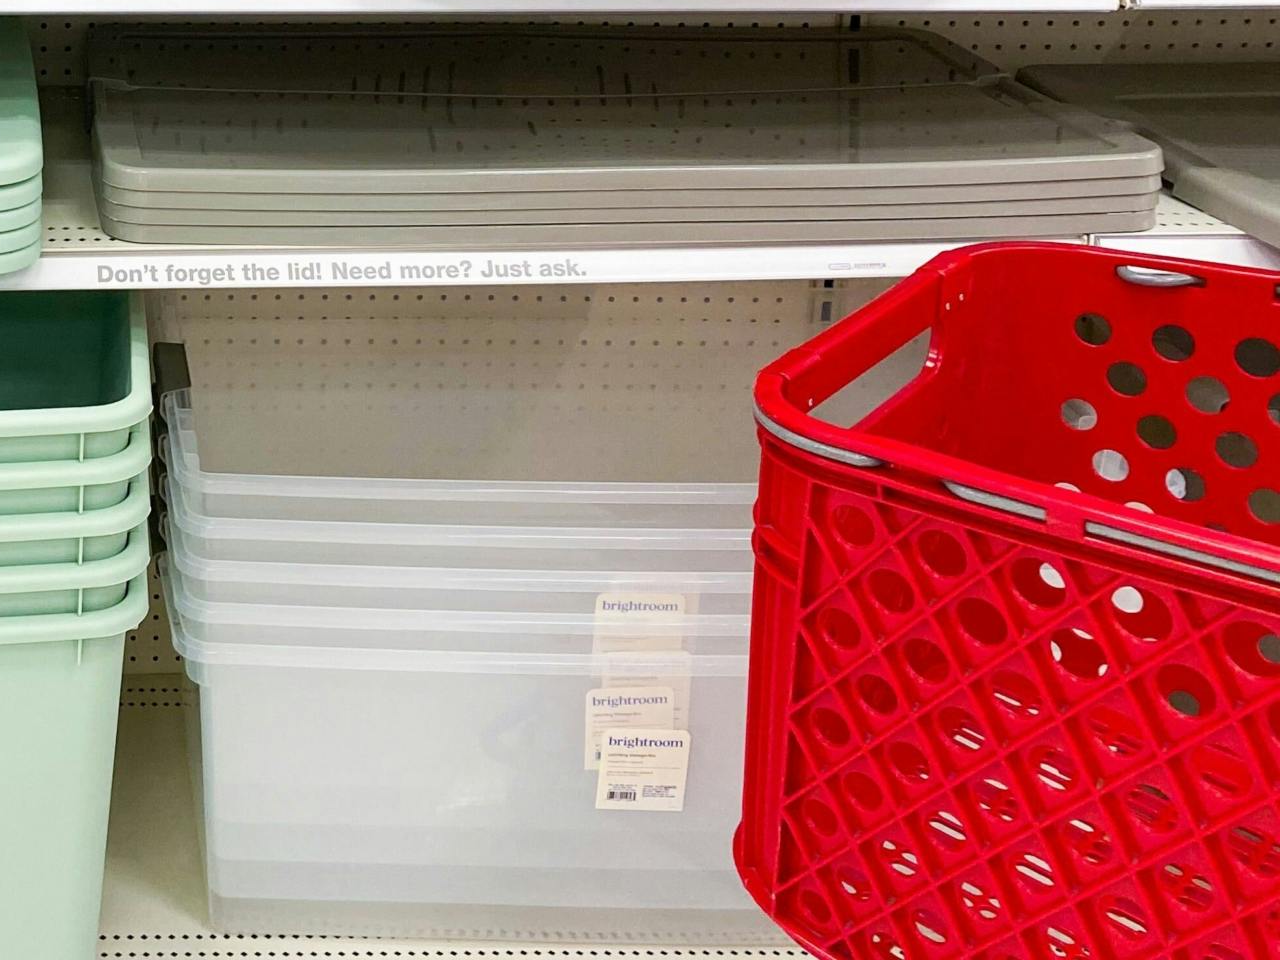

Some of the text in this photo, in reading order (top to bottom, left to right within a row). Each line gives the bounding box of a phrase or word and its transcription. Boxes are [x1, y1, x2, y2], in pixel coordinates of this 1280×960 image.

[97, 258, 587, 286] Don't forget the lid! Need more? Just ask.
[602, 600, 679, 613] brightroom
[592, 694, 668, 708] brightroom
[608, 736, 684, 749] brightroom
